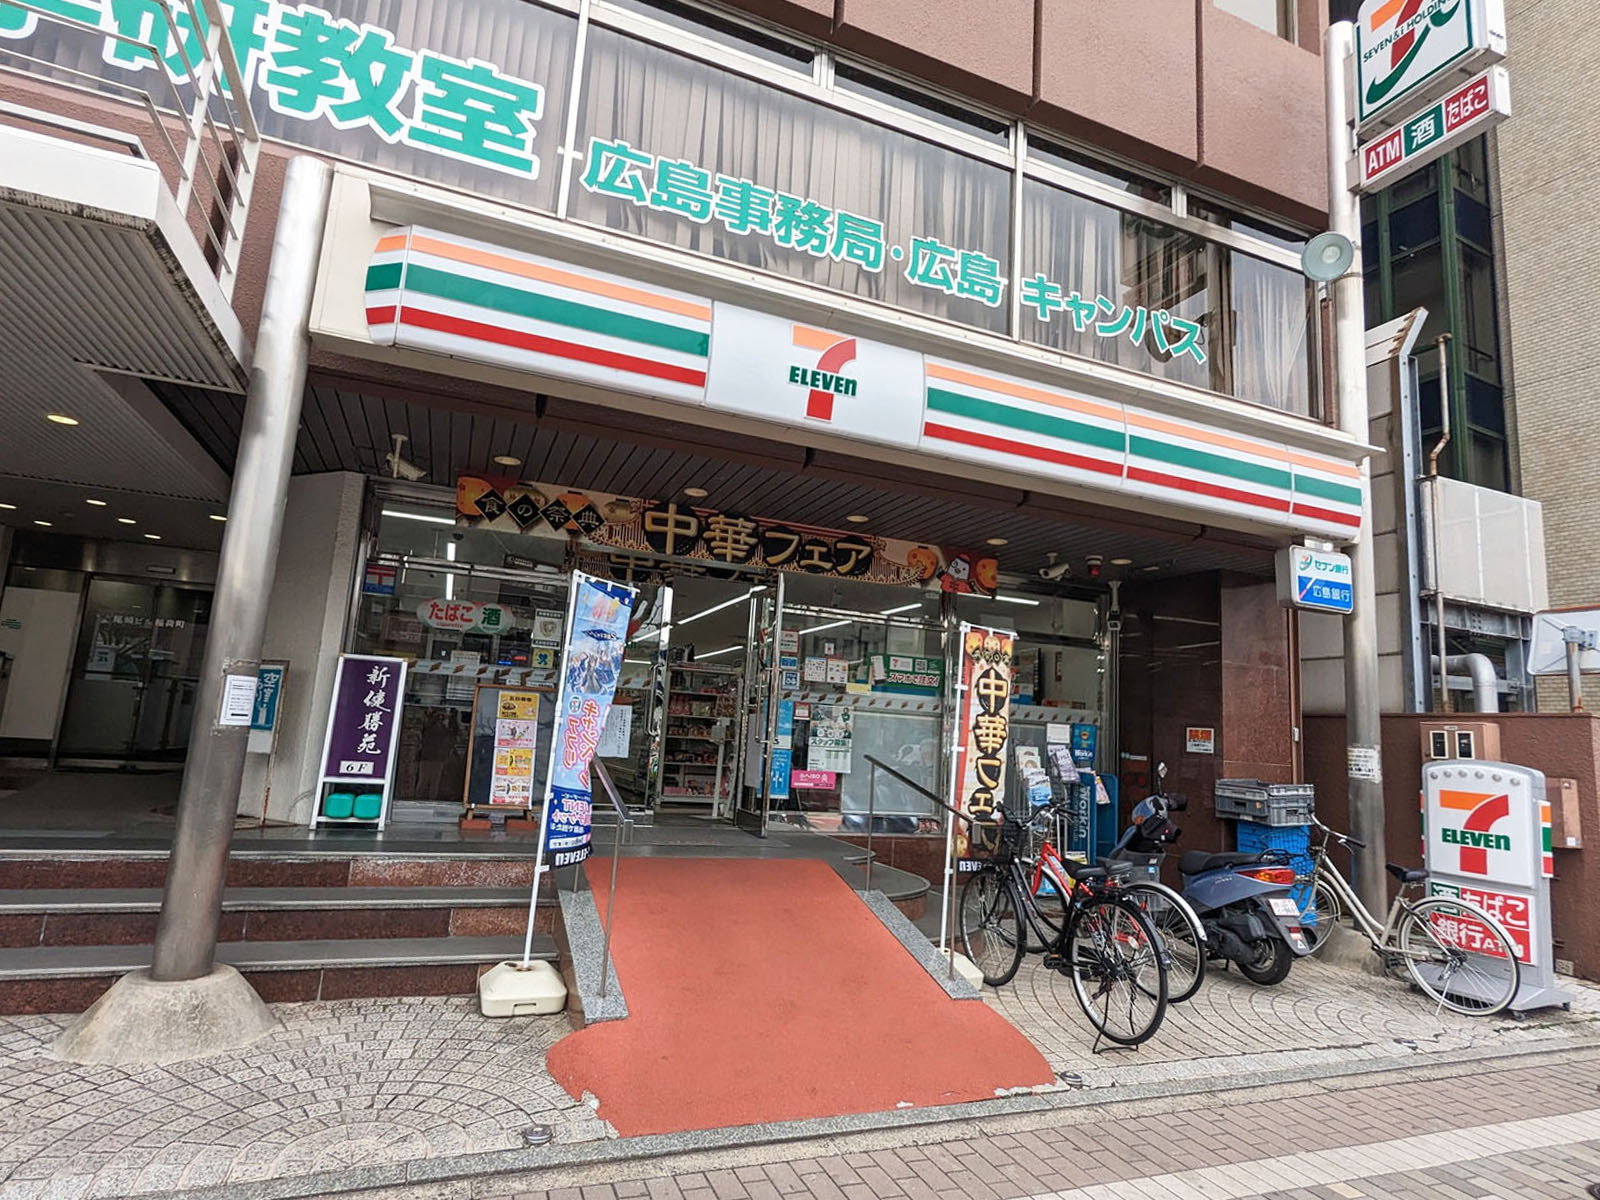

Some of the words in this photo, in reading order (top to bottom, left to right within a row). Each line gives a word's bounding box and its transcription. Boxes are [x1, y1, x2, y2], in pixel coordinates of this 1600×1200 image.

[1406, 0, 1456, 31] HOLDIN
[0, 0, 542, 176] 研教室
[1366, 136, 1401, 176] ATM
[1409, 112, 1436, 149] 酒
[1446, 81, 1488, 127] たばこ
[1018, 273, 1208, 365] キャンパス
[482, 496, 600, 529] 食の祭典
[644, 501, 872, 575] 中華フェア
[1314, 559, 1349, 576] セブン銀行
[1312, 584, 1351, 603] 広島銀行
[429, 601, 473, 623] たばこ
[481, 607, 502, 626] 酒
[1079, 786, 1089, 838] Workin
[1462, 890, 1529, 928] たばこ
